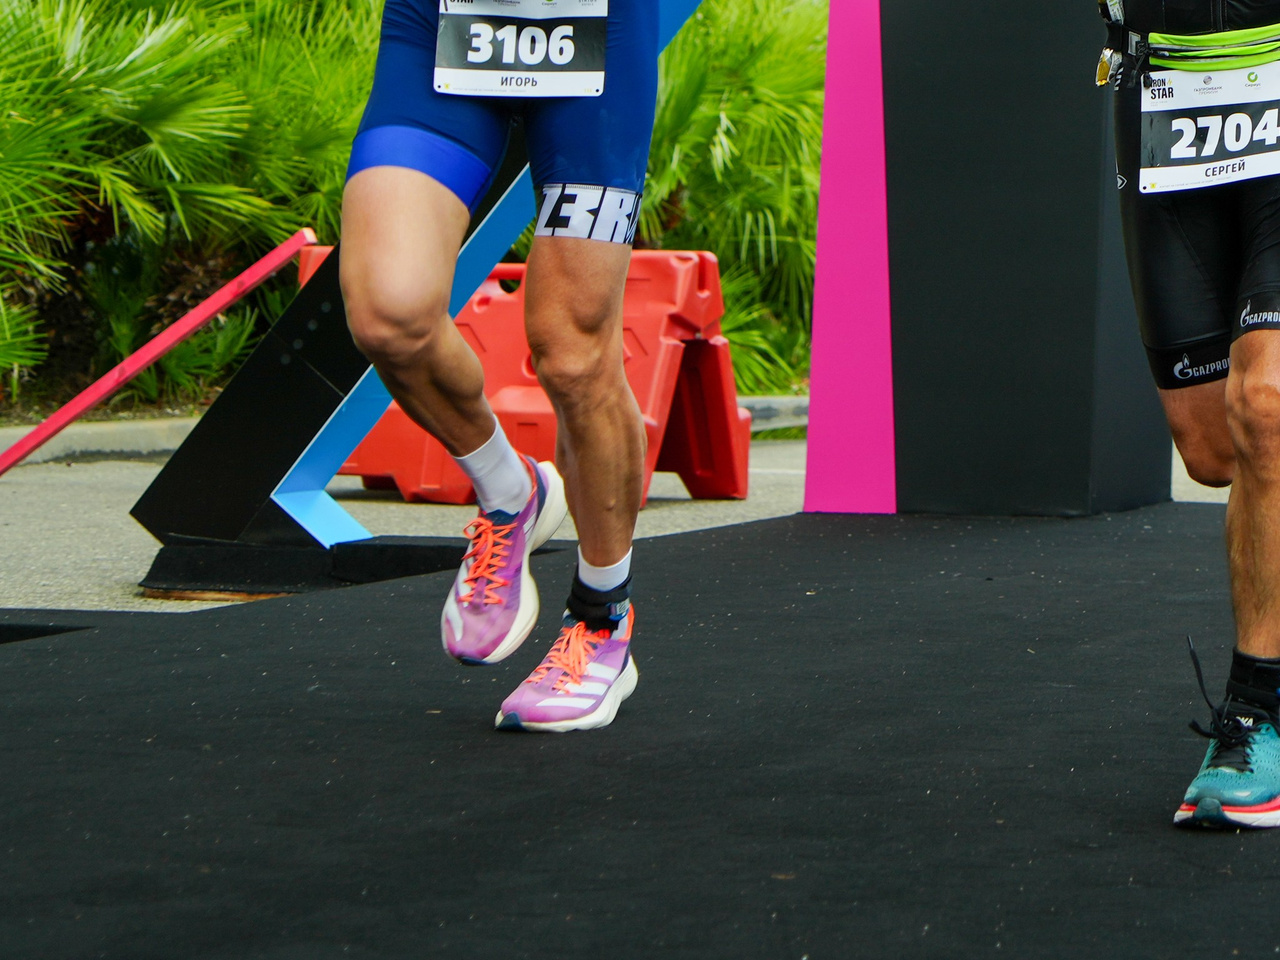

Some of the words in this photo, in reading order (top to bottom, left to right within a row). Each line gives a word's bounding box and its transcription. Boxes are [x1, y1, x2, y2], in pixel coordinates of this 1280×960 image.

[467, 23, 575, 65] 3106
[500, 76, 538, 87] ИГОРЬ
[1151, 87, 1174, 100] STAR
[1204, 159, 1246, 178] СЕРГЕЙ
[1193, 357, 1230, 377] GAZPRO
